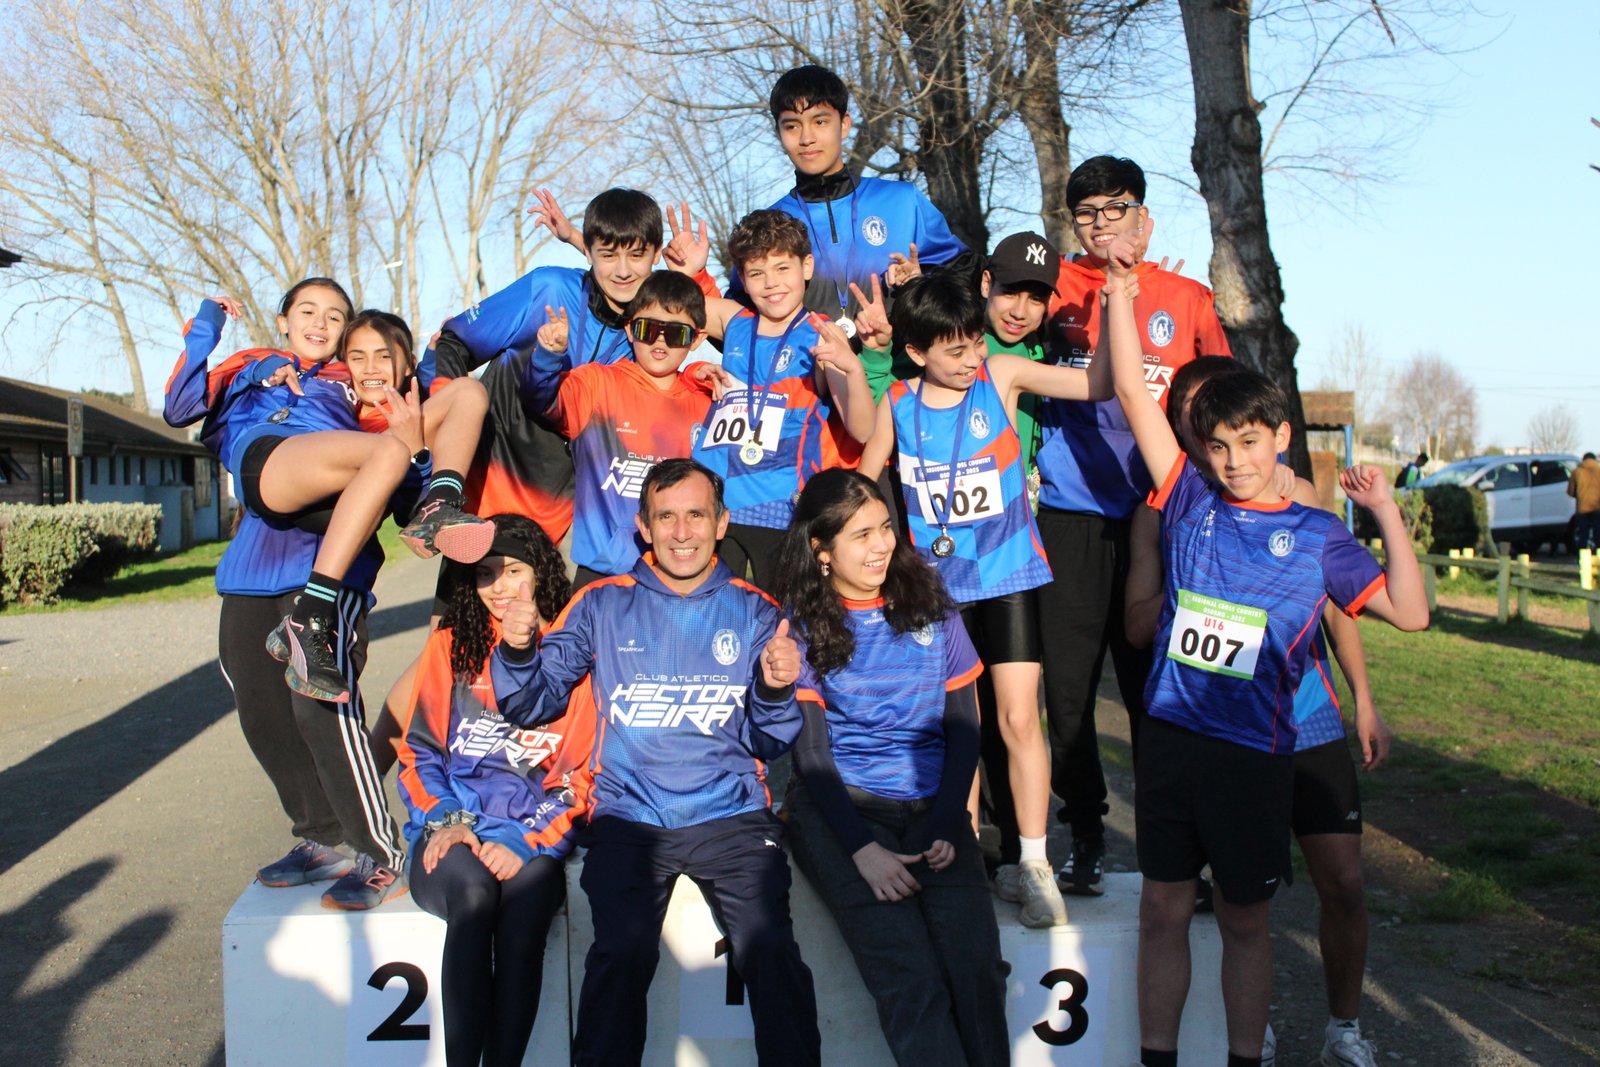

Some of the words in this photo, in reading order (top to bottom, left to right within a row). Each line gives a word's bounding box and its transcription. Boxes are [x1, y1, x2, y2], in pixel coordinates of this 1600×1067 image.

[1026, 243, 1047, 266] NY
[1072, 348, 1096, 356] CLU
[713, 417, 764, 447] 001
[627, 452, 655, 461] CLUB
[968, 456, 992, 467] COUNTRY
[932, 486, 991, 517] 002
[1218, 602, 1236, 612] CROSS
[1204, 617, 1225, 631] U16
[1180, 627, 1245, 668] 007
[635, 673, 669, 682] CLUB
[670, 674, 730, 683] ATLETICO
[609, 682, 748, 709] HECTOR
[609, 701, 737, 736] NEIRA
[456, 717, 564, 754] HECTOR
[449, 734, 553, 769] NEIRA
[366, 961, 431, 1042] 2
[1031, 967, 1090, 1047] 3
